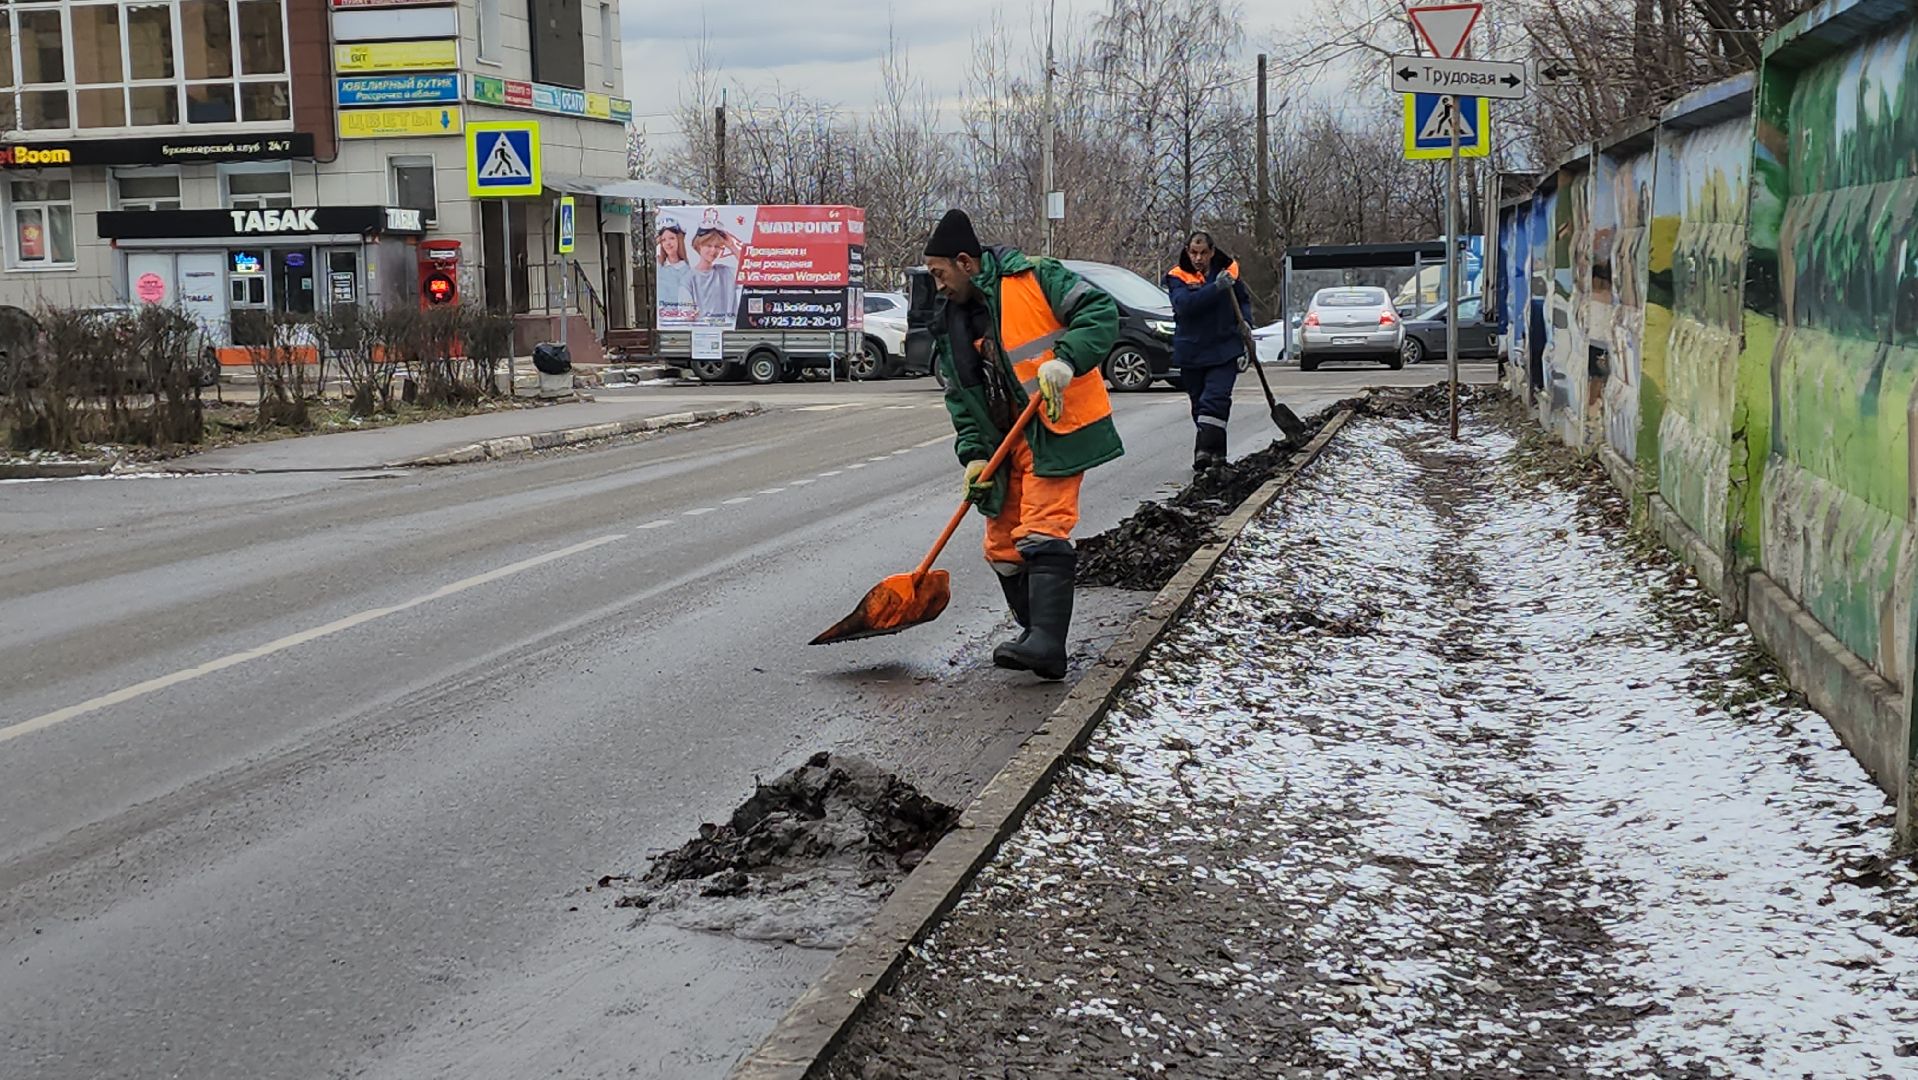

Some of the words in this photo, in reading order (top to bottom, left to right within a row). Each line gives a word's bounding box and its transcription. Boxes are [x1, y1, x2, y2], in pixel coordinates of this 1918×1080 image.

[1422, 66, 1497, 86] Трудовая
[341, 77, 415, 92] ЮВЕЛИРНЫЙ
[416, 77, 453, 89] БУТИК
[348, 111, 433, 131] ЦВЕТЫ
[236, 141, 261, 154] клуб
[267, 140, 291, 151] 24/7
[230, 208, 319, 232] ТАБАК
[385, 208, 422, 231] ТАБАК
[757, 221, 843, 234] WARPOINT
[762, 260, 814, 271] рождения
[795, 271, 842, 283] Warpoint
